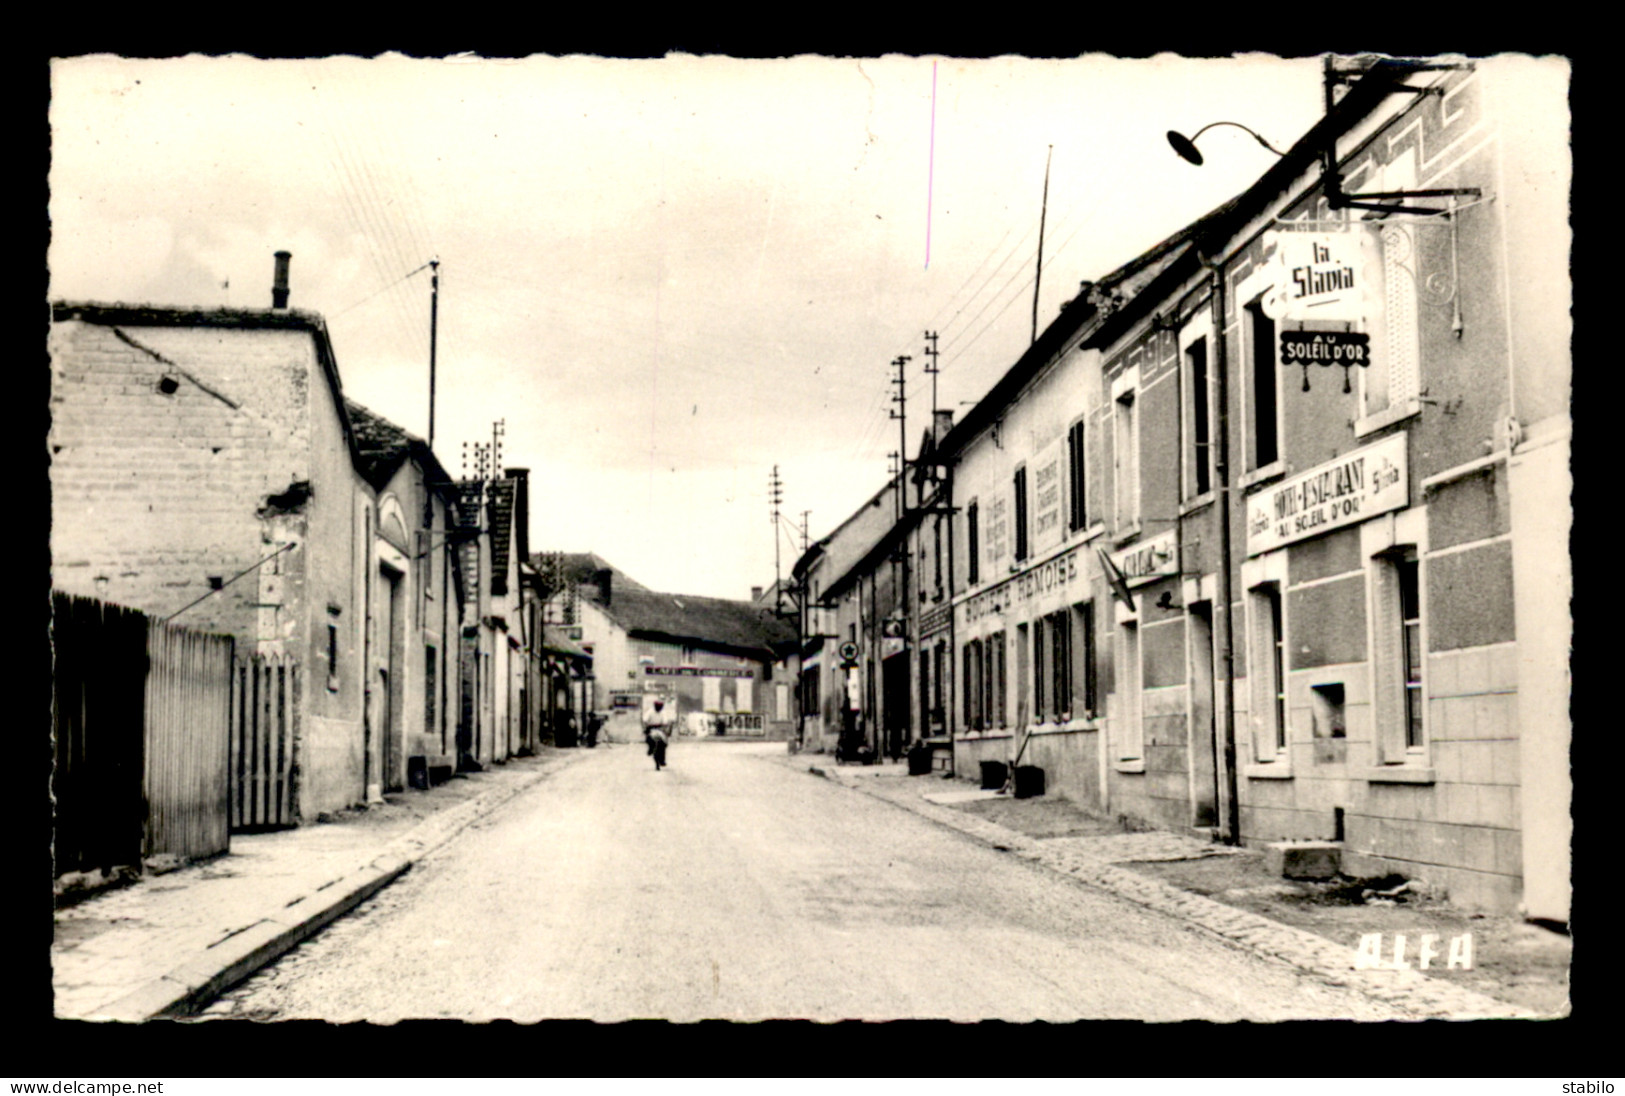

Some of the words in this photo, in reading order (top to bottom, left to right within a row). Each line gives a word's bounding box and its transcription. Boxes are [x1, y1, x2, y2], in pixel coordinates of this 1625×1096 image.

[1292, 260, 1354, 299] Slavia
[1313, 334, 1337, 344] AU
[1286, 341, 1331, 360] SOLEIL
[1333, 343, 1364, 361] D'OR
